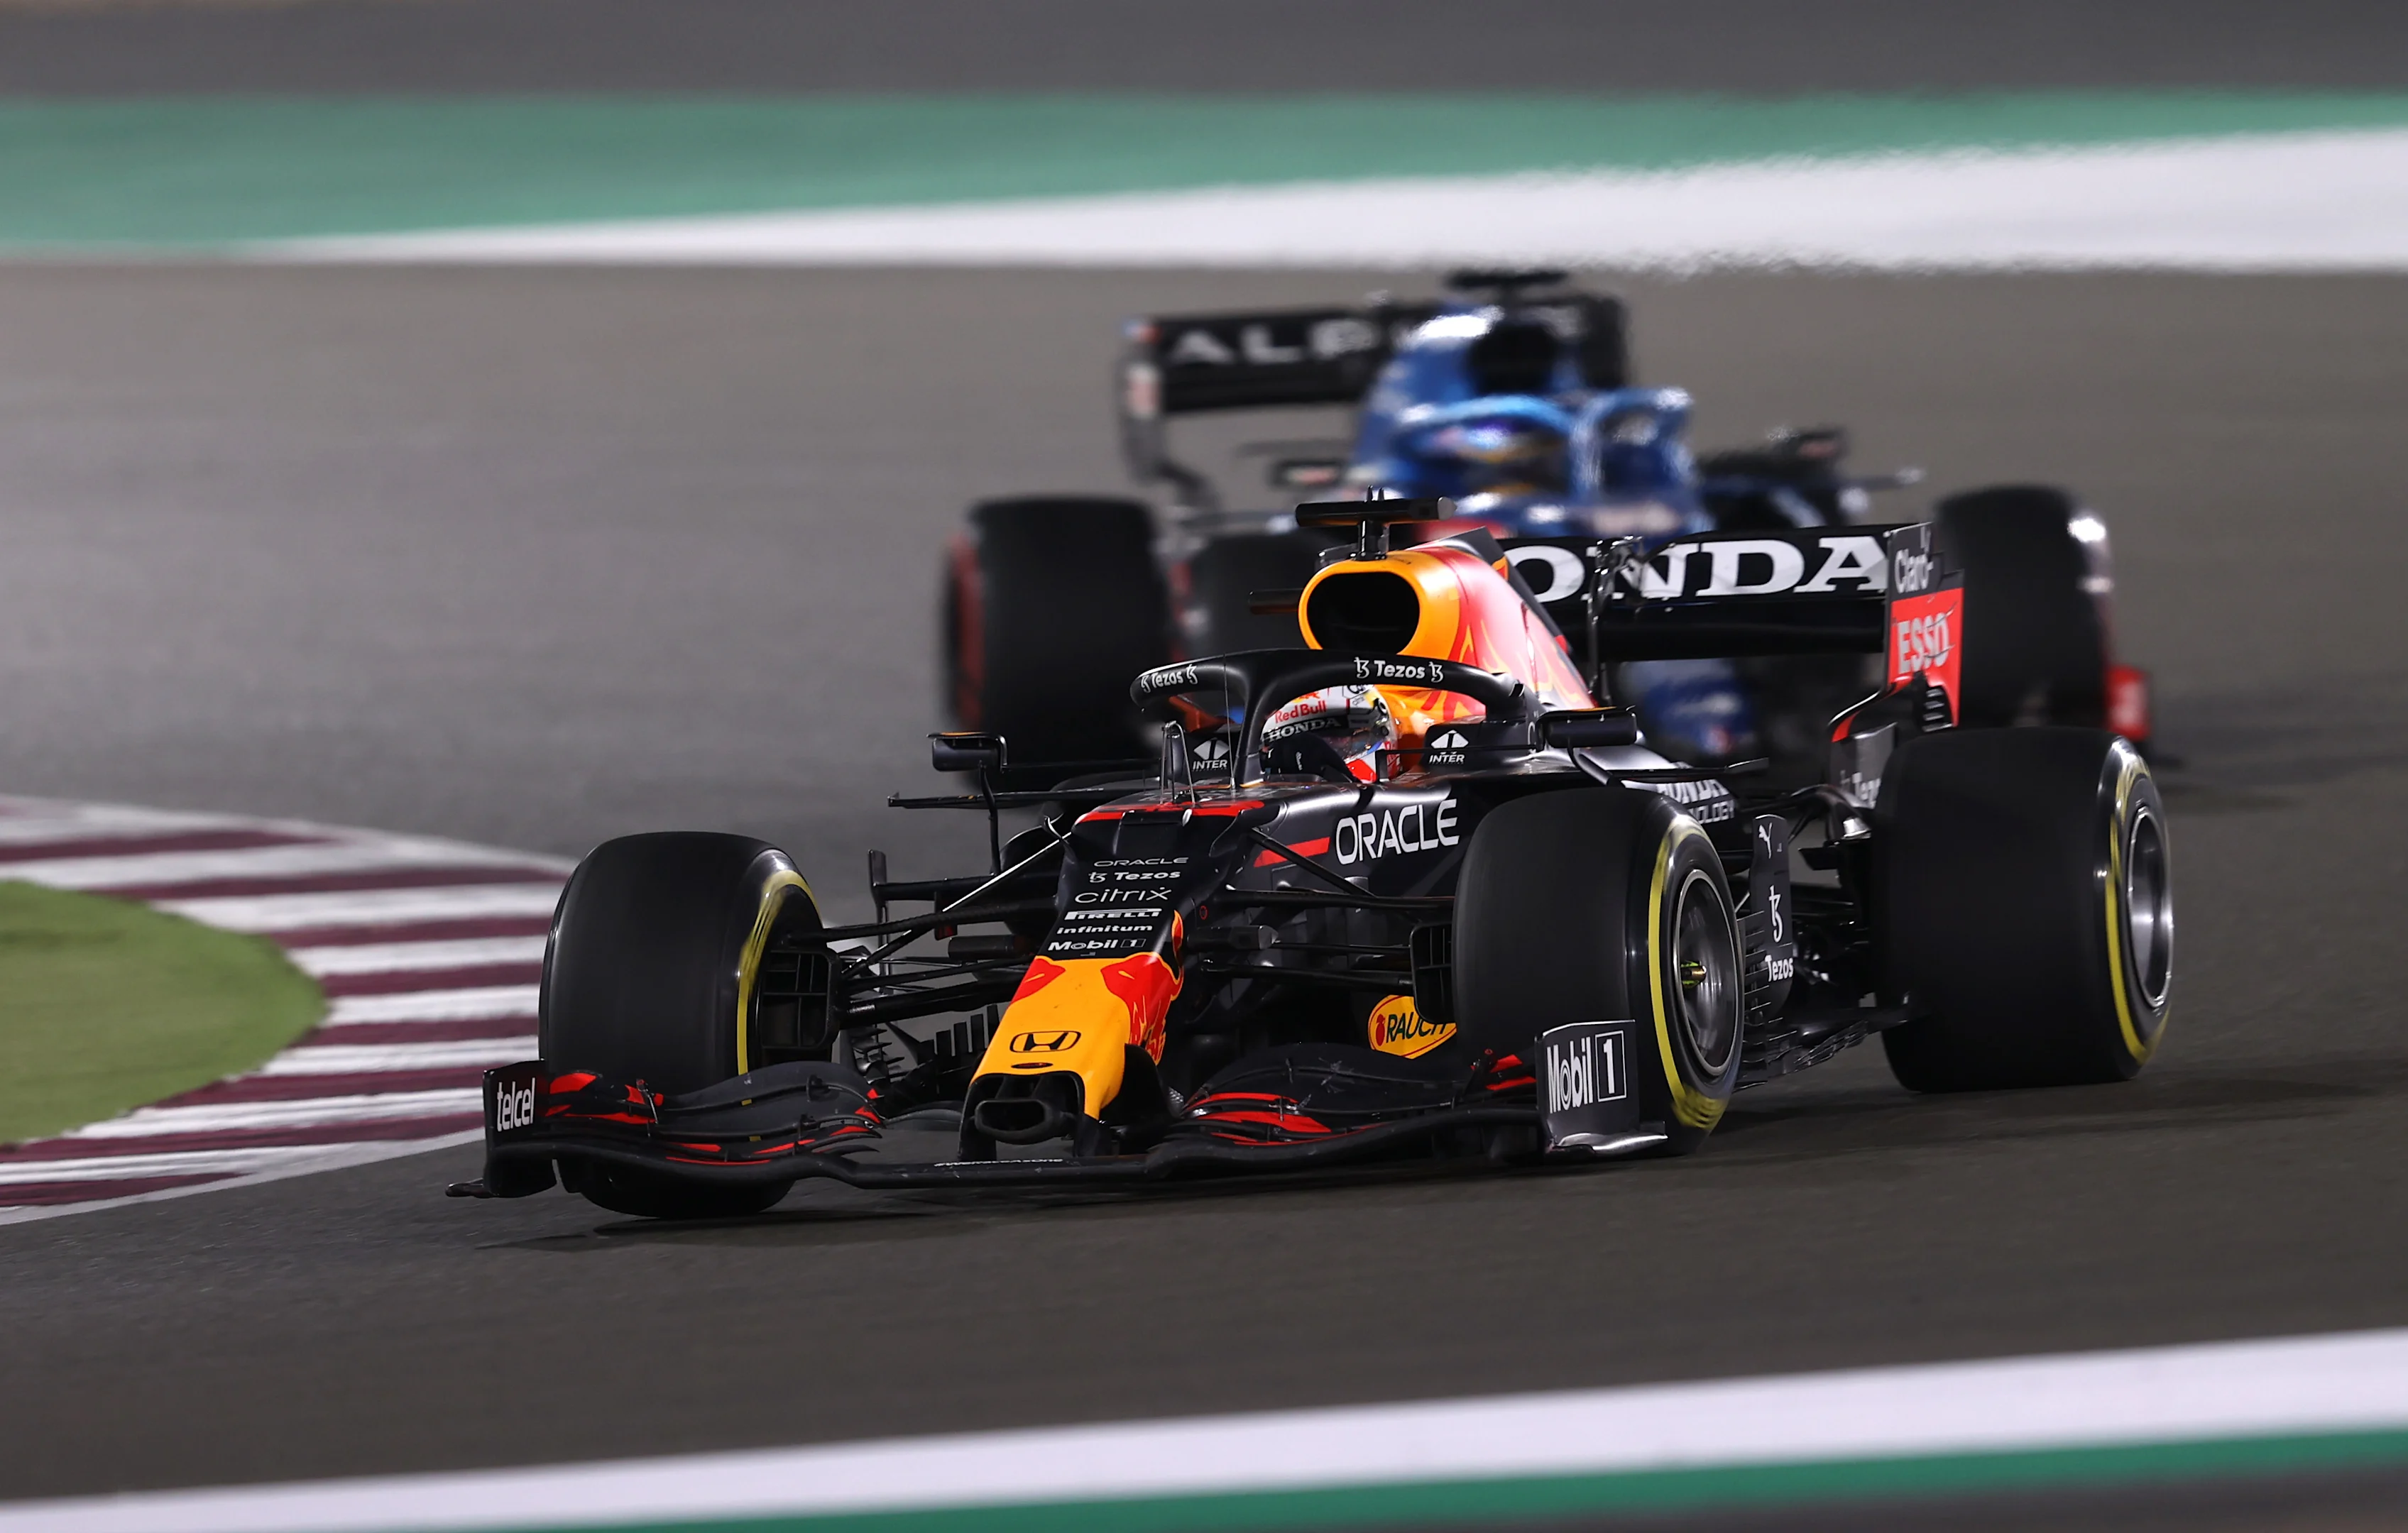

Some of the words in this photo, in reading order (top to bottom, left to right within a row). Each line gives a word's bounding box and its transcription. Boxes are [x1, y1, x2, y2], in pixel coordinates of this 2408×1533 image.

[1173, 318, 1381, 364] ALP
[1504, 536, 1886, 603] ONDA
[1894, 548, 1930, 594] Claro
[1374, 659, 1425, 679] Tezos
[1151, 670, 1184, 689] Tezos
[1264, 717, 1341, 743] HONDA
[1192, 759, 1228, 770] INTER
[1428, 754, 1465, 764] INTER
[1335, 798, 1460, 865] ORACLE
[1094, 857, 1189, 867] ORACLE
[1114, 872, 1181, 881] Tezos
[1064, 908, 1162, 920] PIRELLI
[1056, 925, 1153, 935] infinitum
[1048, 939, 1119, 951] Mobil
[1765, 954, 1794, 982] Tezos
[1547, 1036, 1594, 1114] Mobil
[497, 1077, 536, 1132] telcel
